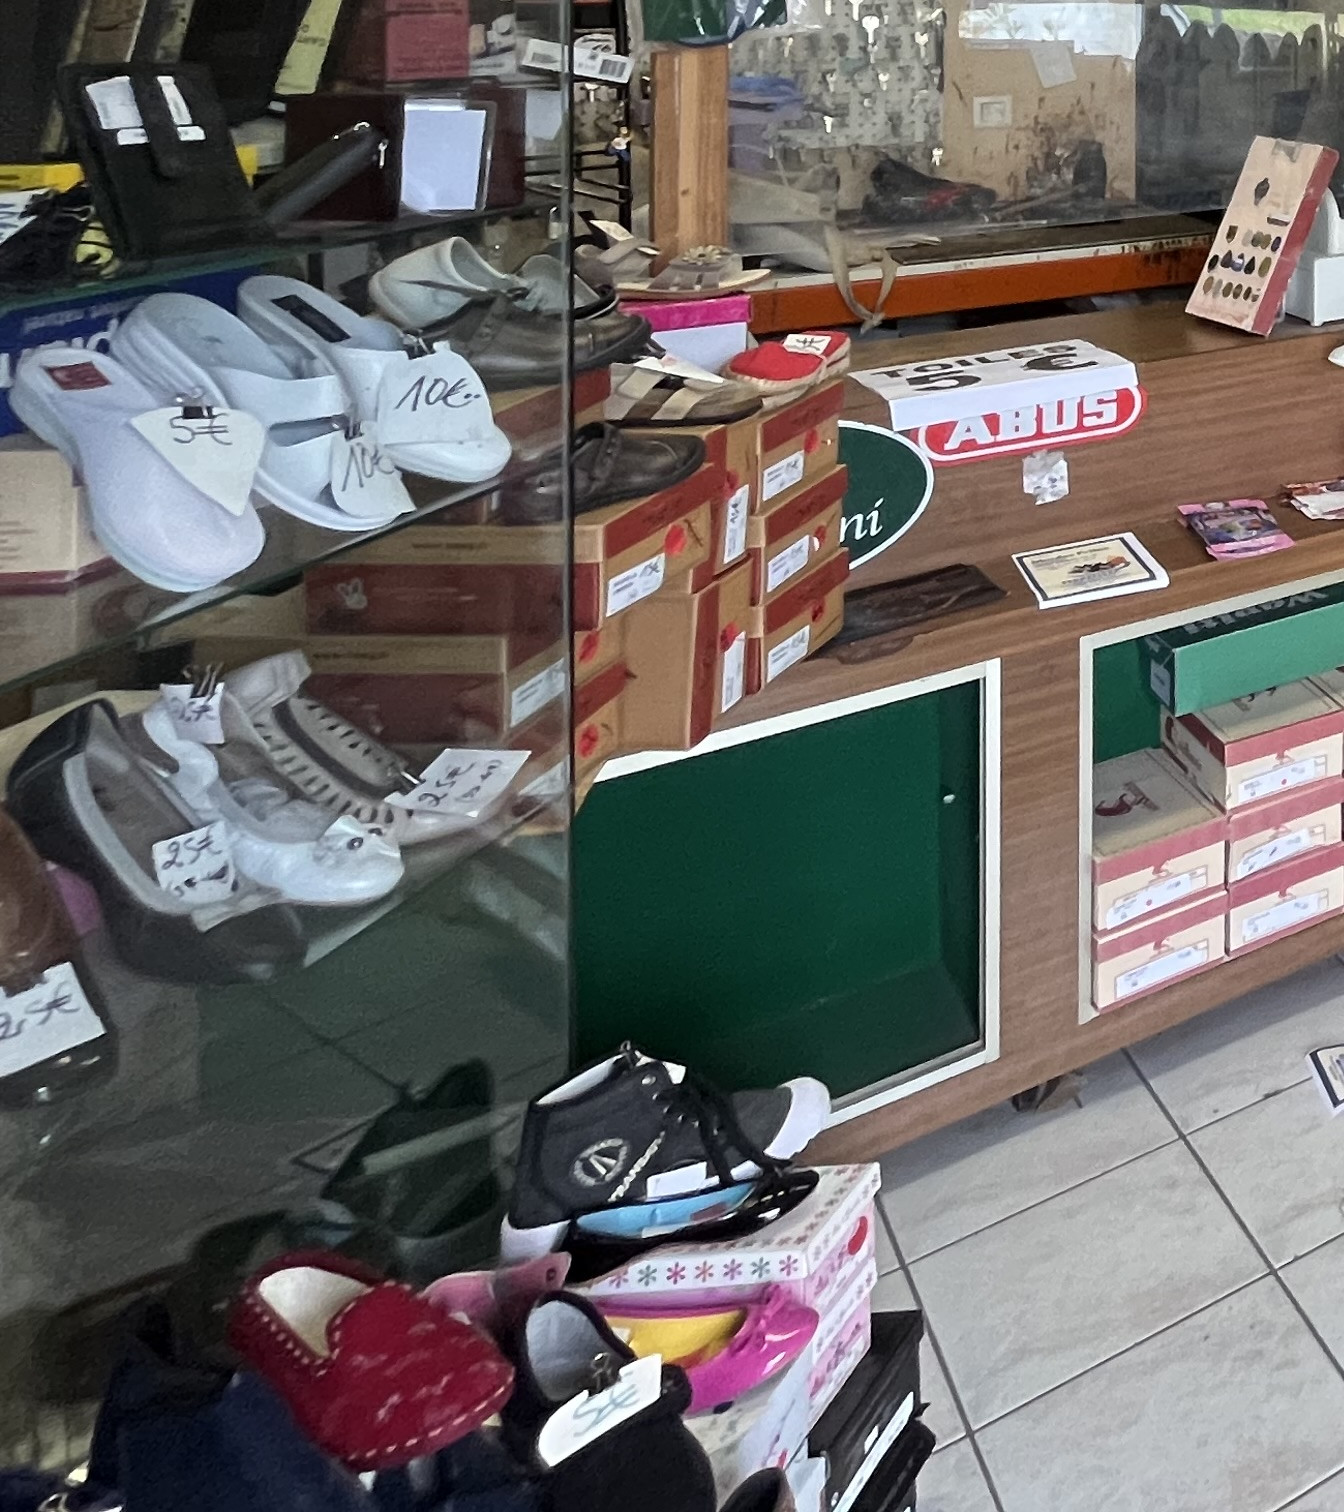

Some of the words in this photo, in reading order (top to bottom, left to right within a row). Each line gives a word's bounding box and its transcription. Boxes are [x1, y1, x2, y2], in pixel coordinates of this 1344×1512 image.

[906, 369, 982, 392] 5
[1020, 352, 1099, 372] €
[170, 413, 233, 446] 5€
[944, 390, 1118, 452] ABUS
